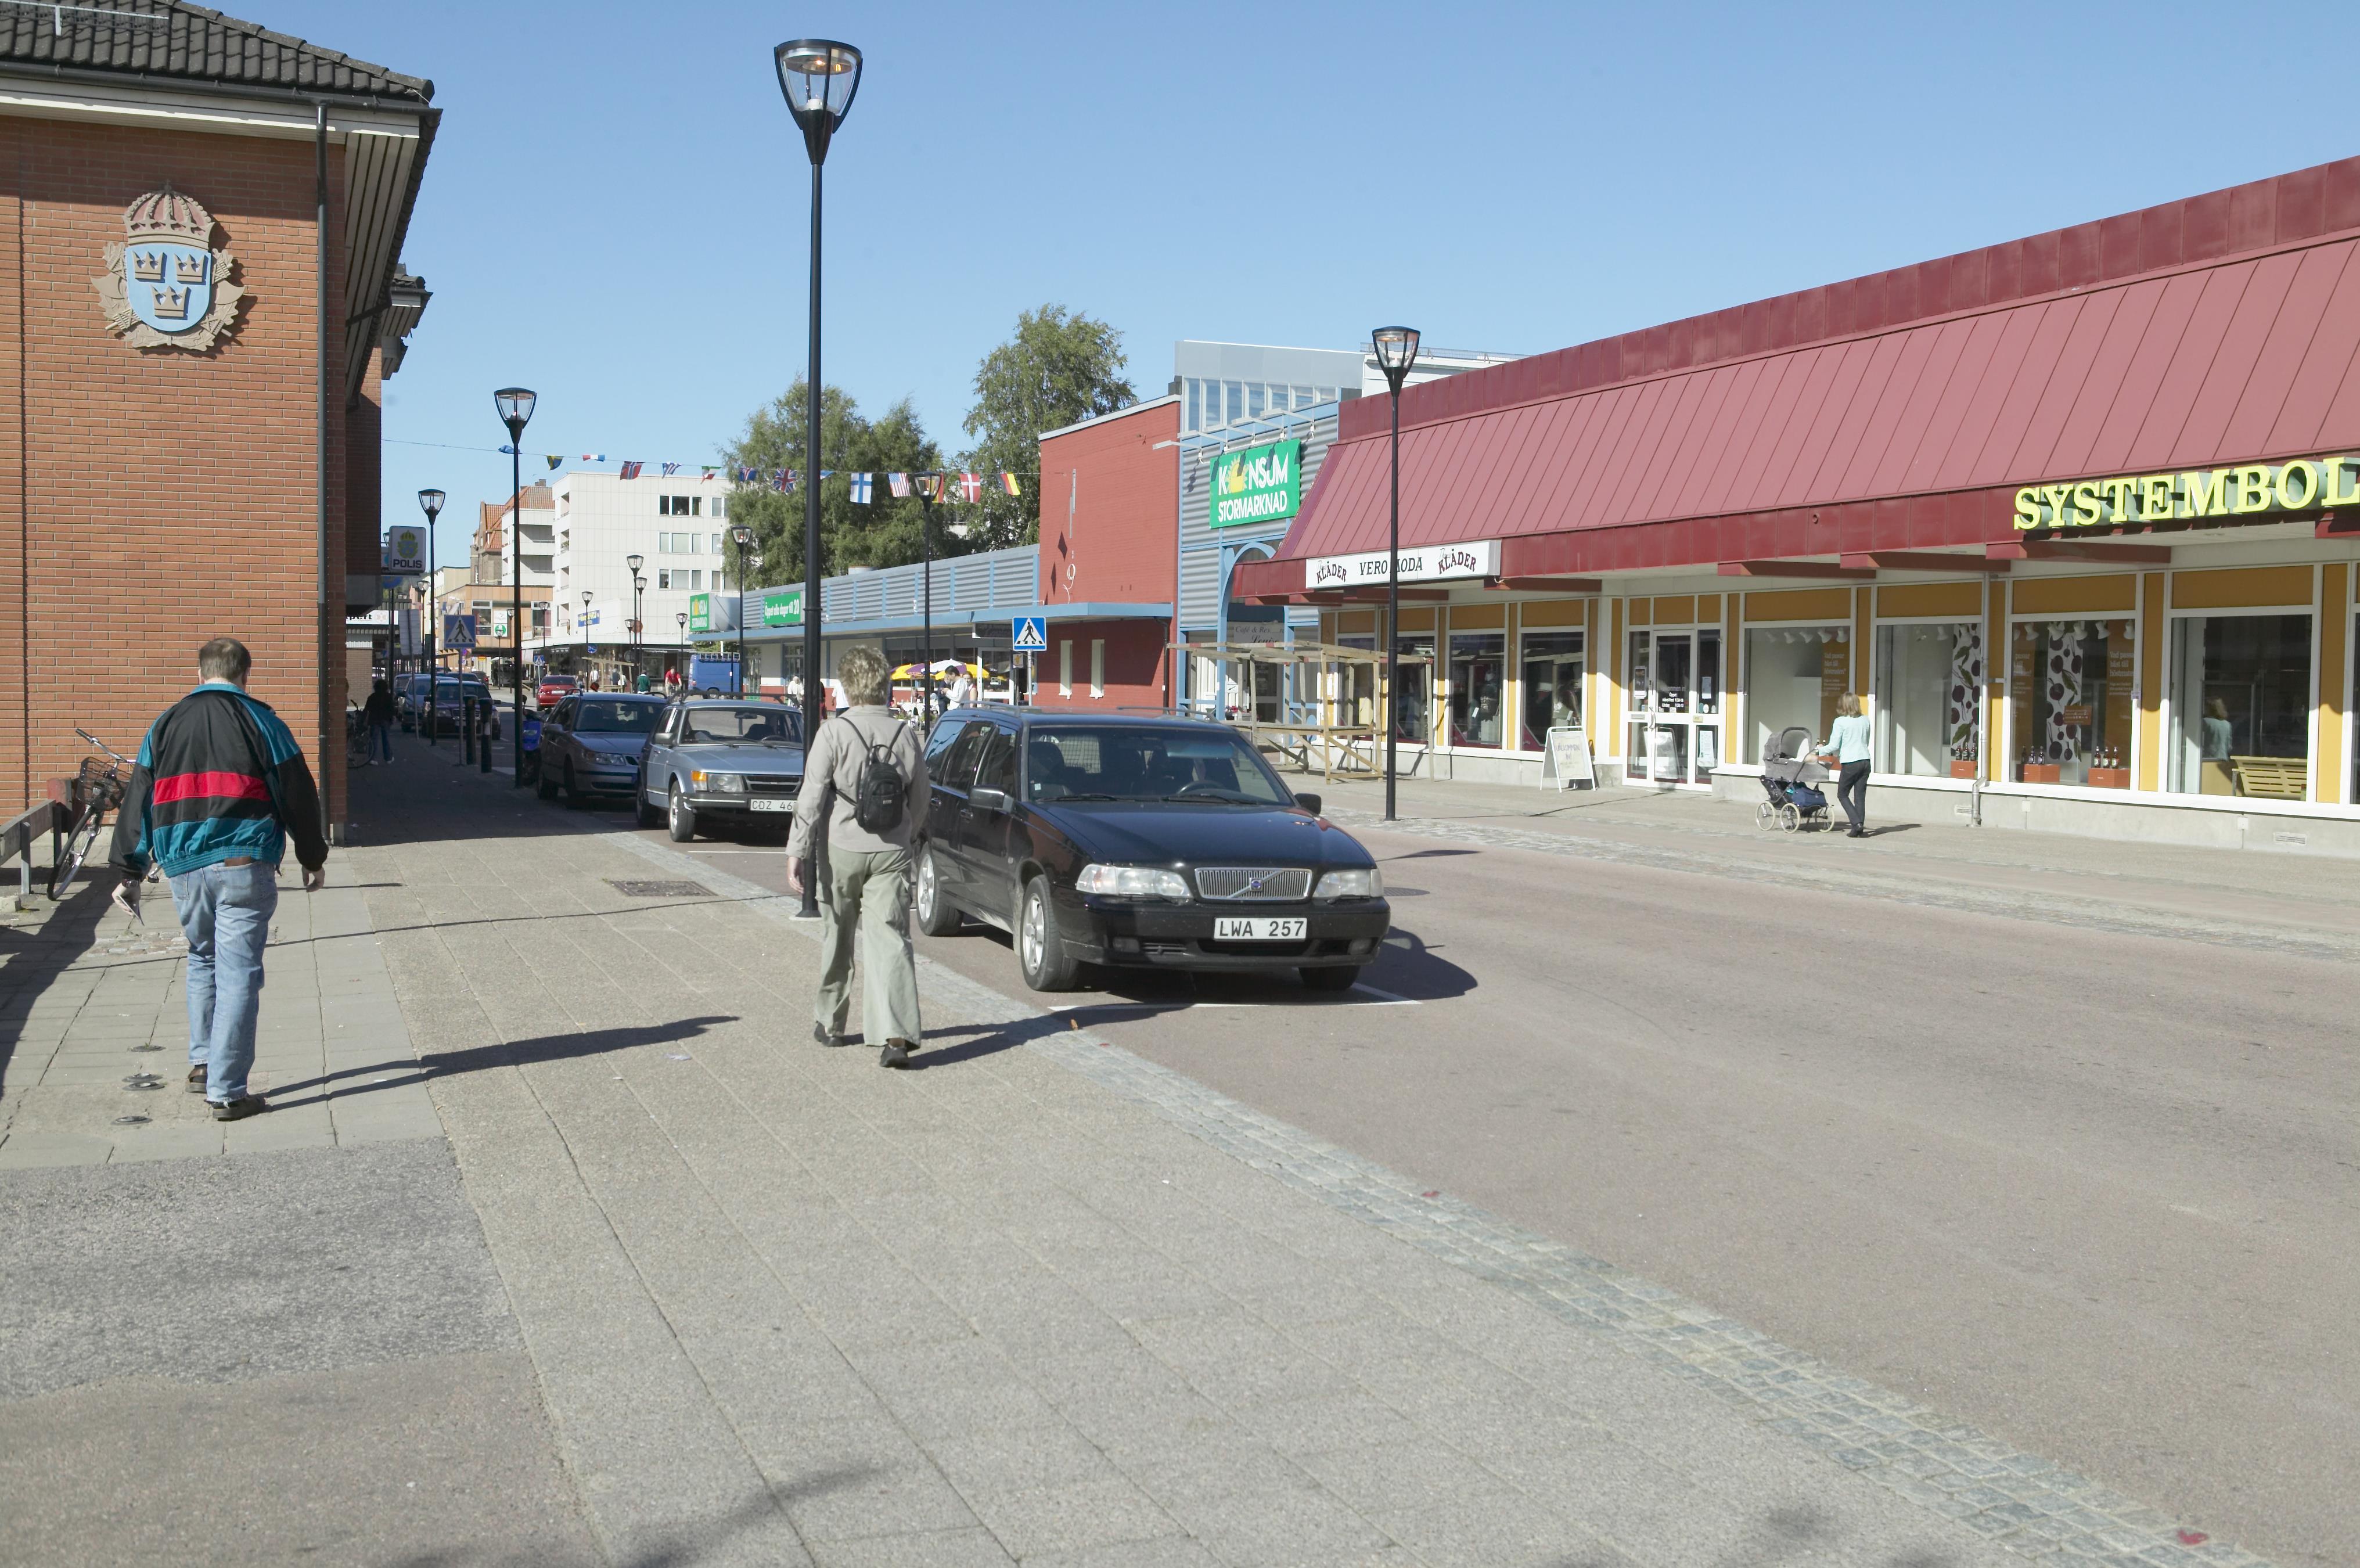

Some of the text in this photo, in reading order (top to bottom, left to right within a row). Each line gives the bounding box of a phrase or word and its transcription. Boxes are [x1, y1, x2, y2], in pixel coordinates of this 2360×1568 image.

[2013, 456, 2360, 530] SYSTEMBOL
[1218, 491, 1287, 523] STORMARKNAD
[393, 559, 423, 568] POLIS
[1359, 560, 1388, 576] VERO
[793, 599, 799, 614] 20
[752, 800, 772, 810] CDZ
[1219, 920, 1304, 937] LWA 257
